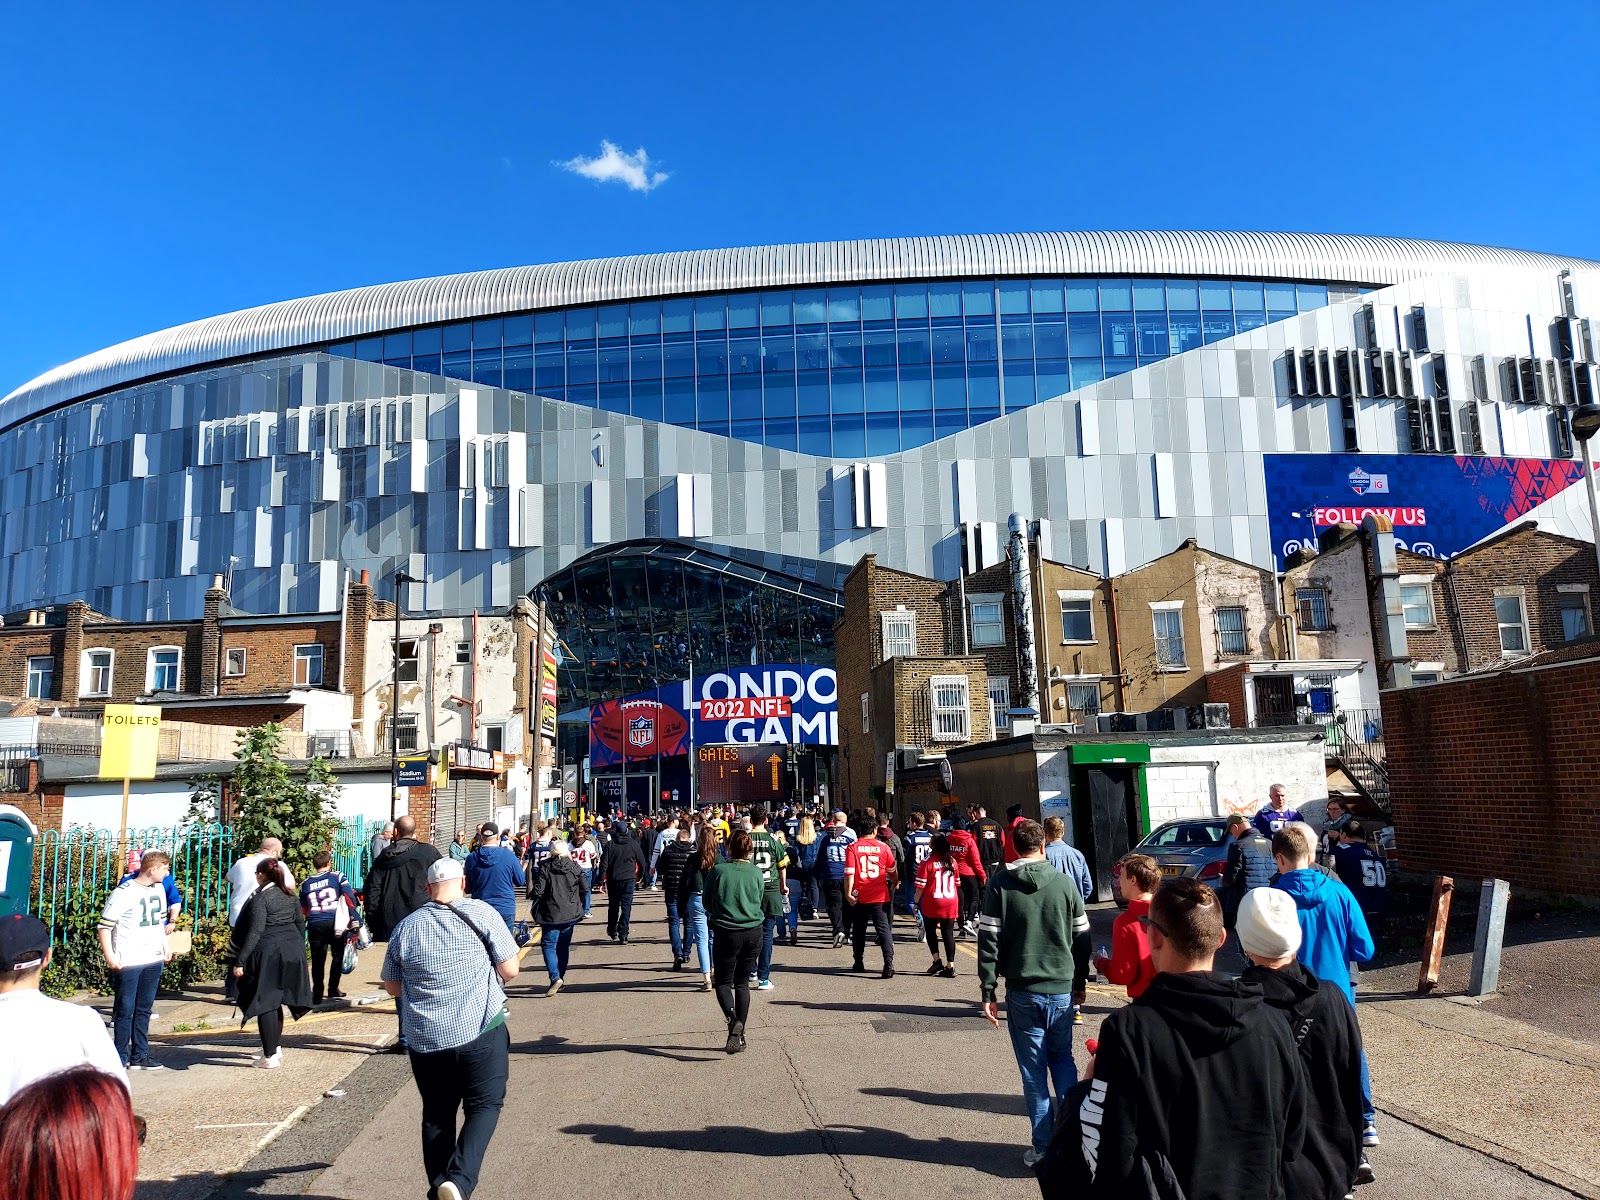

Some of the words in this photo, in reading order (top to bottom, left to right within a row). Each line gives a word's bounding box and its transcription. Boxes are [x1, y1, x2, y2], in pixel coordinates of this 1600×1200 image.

[1374, 481, 1383, 489] IG
[1402, 508, 1426, 525] US
[704, 699, 745, 719] 2022
[750, 698, 787, 716] NFL
[105, 715, 159, 726] TOILETS
[632, 729, 651, 743] NFL
[699, 747, 738, 761] GATES
[719, 764, 724, 779] 1
[746, 763, 755, 777] 4
[859, 855, 880, 879] 15
[1360, 860, 1386, 887] 50
[309, 878, 329, 891] BRADY
[933, 870, 956, 899] 10
[308, 887, 338, 911] 12
[139, 895, 162, 927] 12
